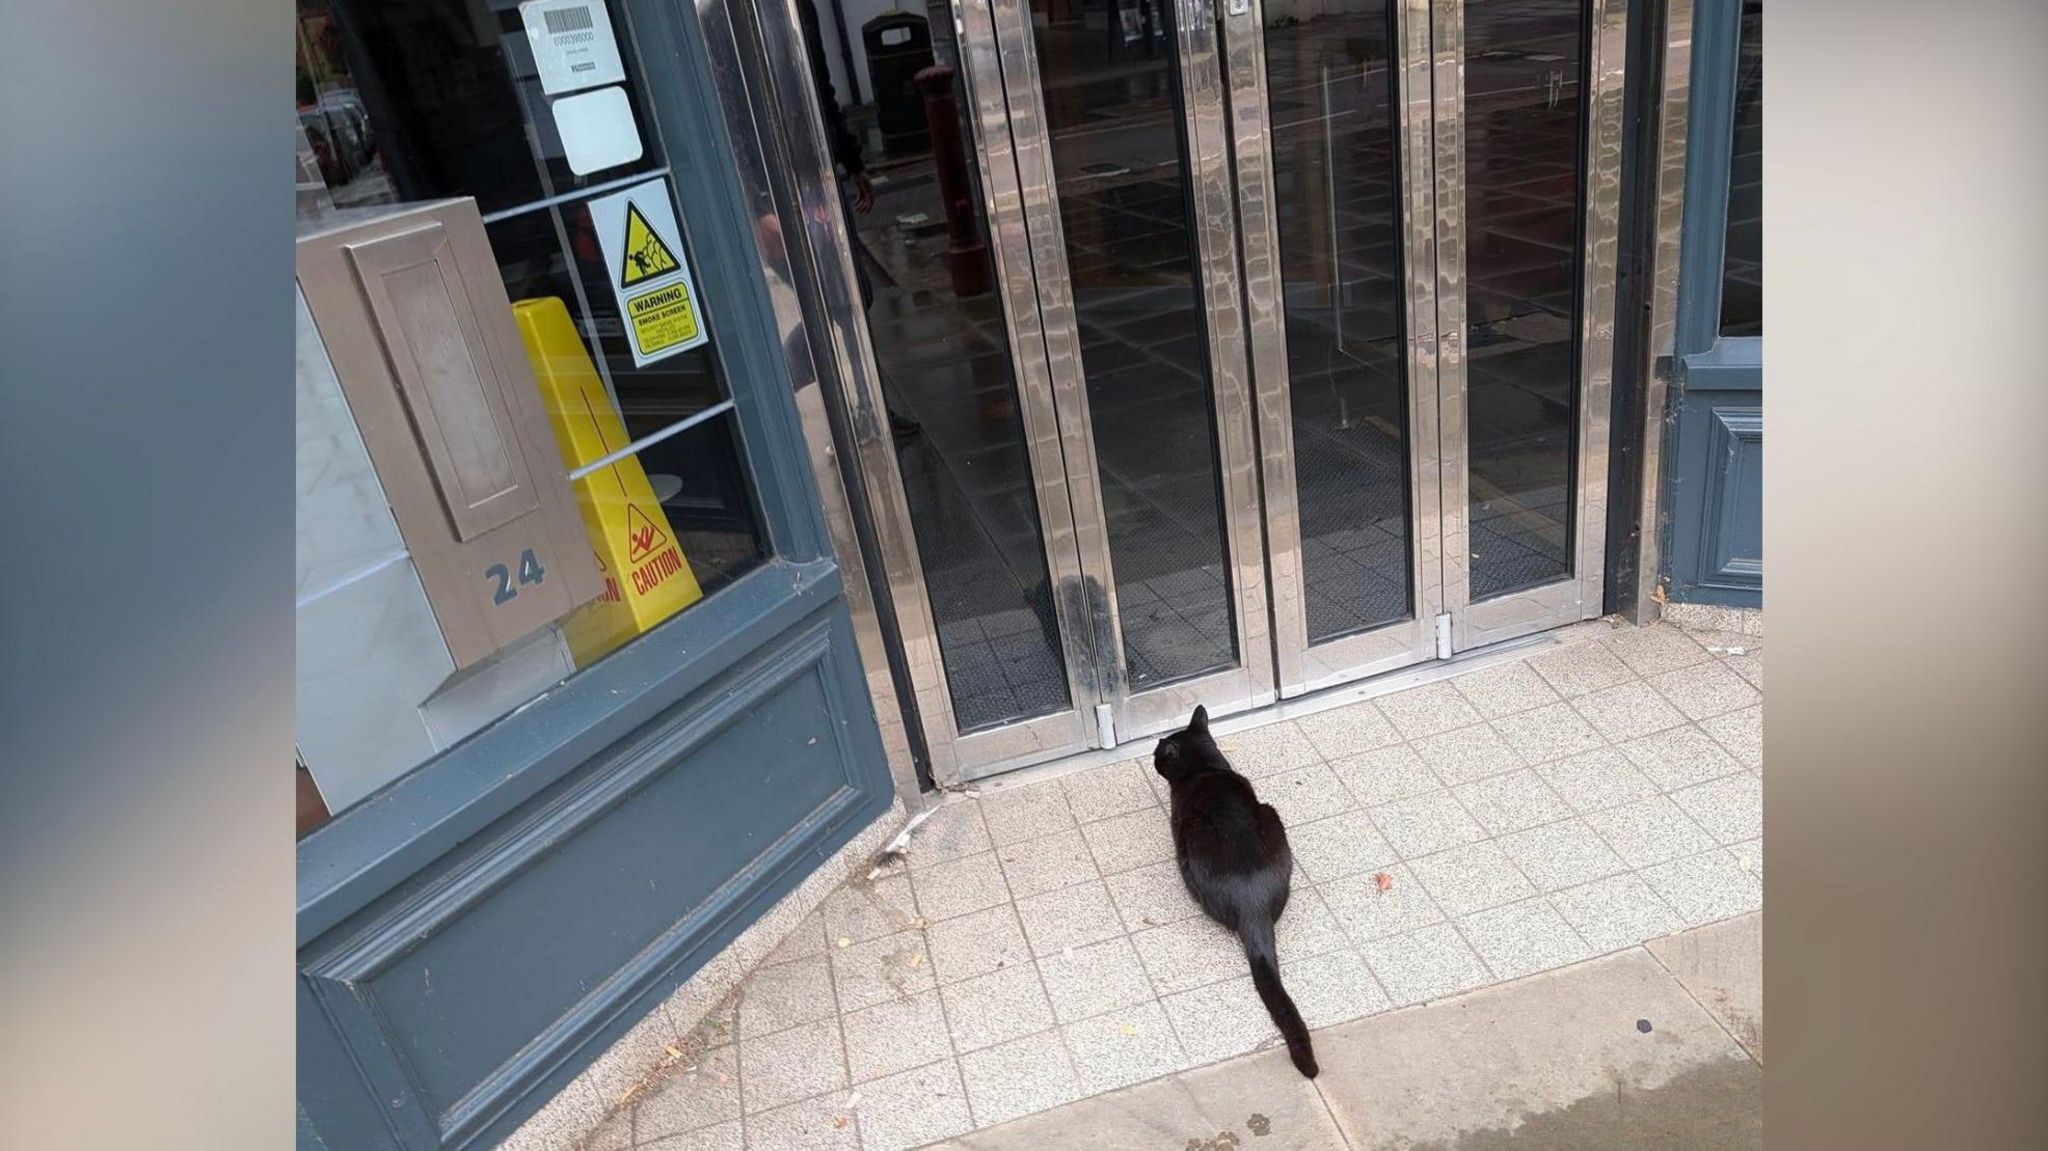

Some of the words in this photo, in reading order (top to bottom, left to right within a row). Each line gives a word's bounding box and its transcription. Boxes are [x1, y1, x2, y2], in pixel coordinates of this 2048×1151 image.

[634, 288, 682, 313] WARNING
[638, 313, 661, 326] SMOKE
[662, 304, 686, 318] SCREEN
[485, 548, 545, 606] 24
[632, 545, 682, 595] CAUTION
